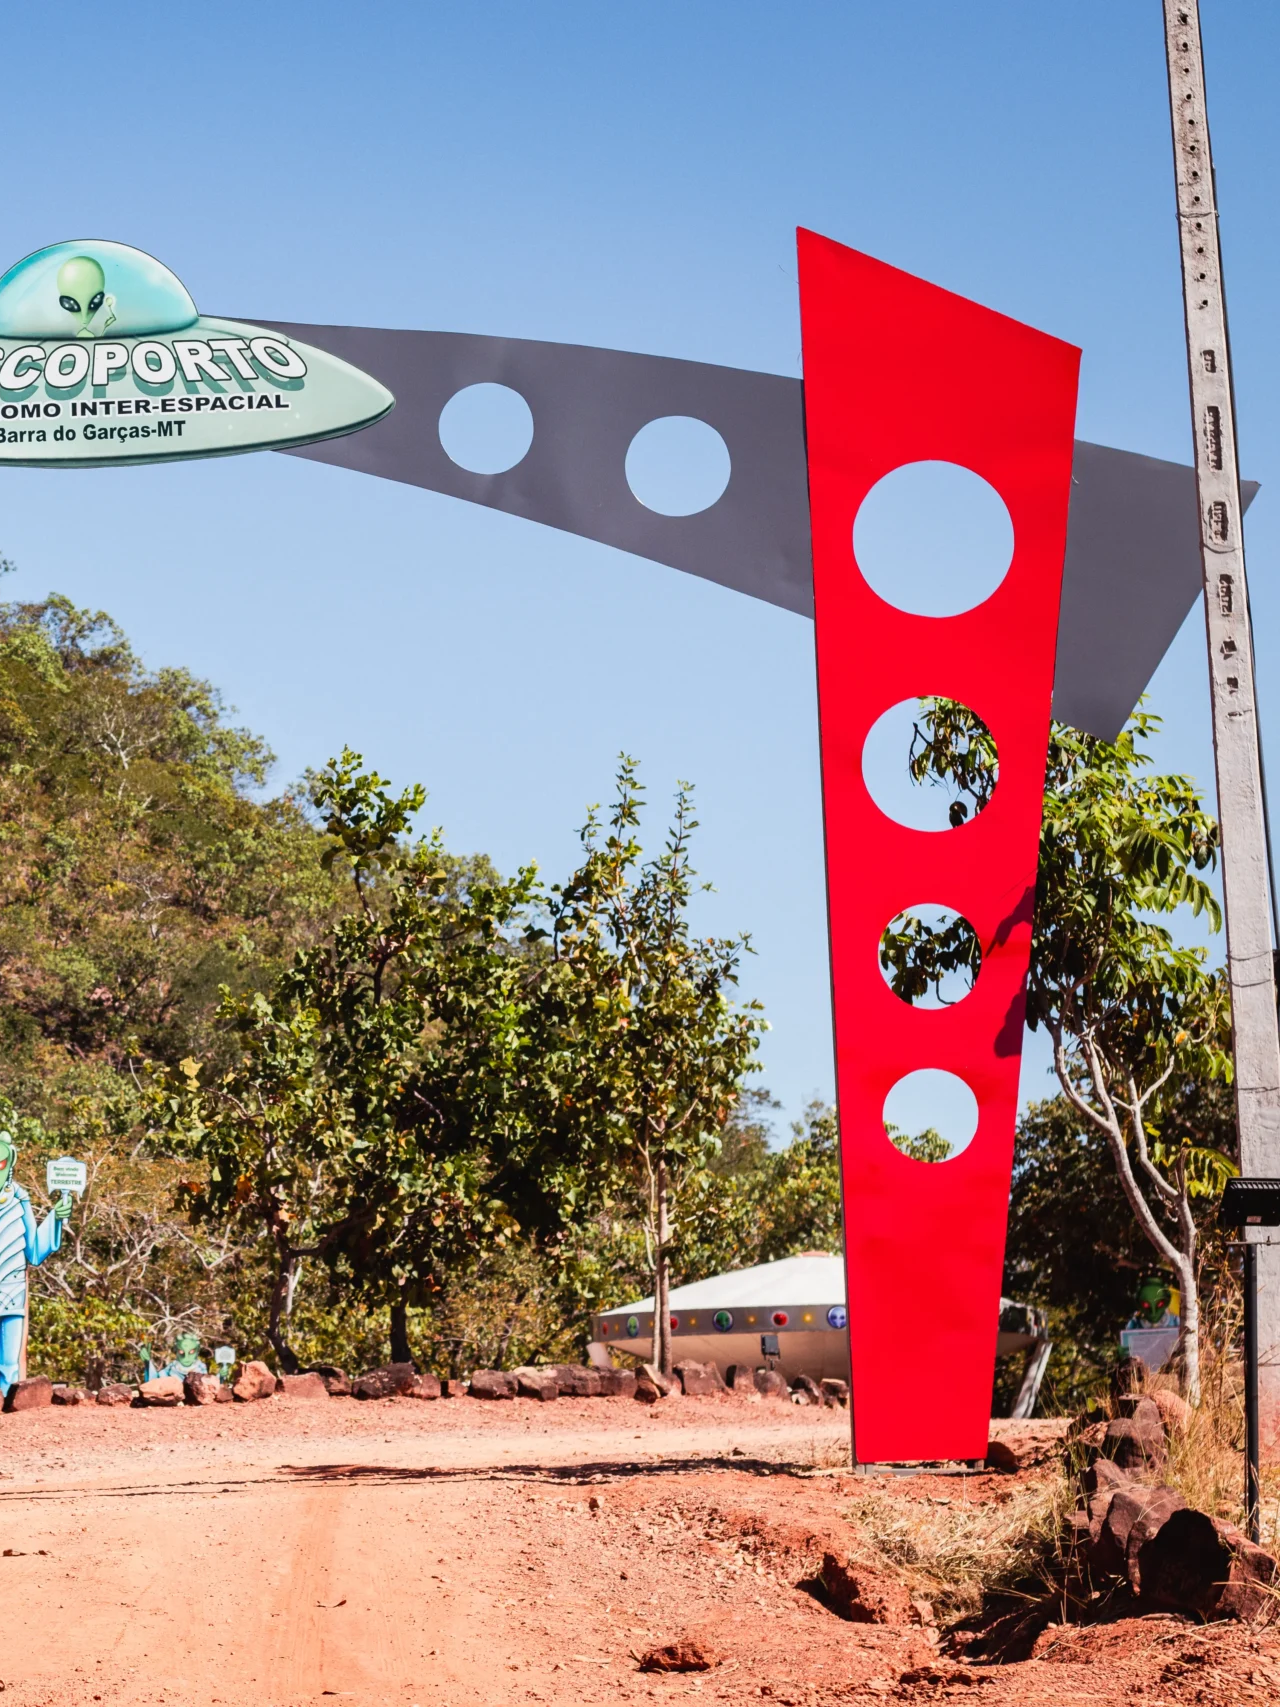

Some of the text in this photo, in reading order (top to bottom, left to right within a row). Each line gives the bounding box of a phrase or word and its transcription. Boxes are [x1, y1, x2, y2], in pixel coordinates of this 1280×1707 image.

[71, 394, 290, 417] INTER-ESPACIAL
[53, 425, 76, 441] do
[82, 420, 187, 444] Garças-MT
